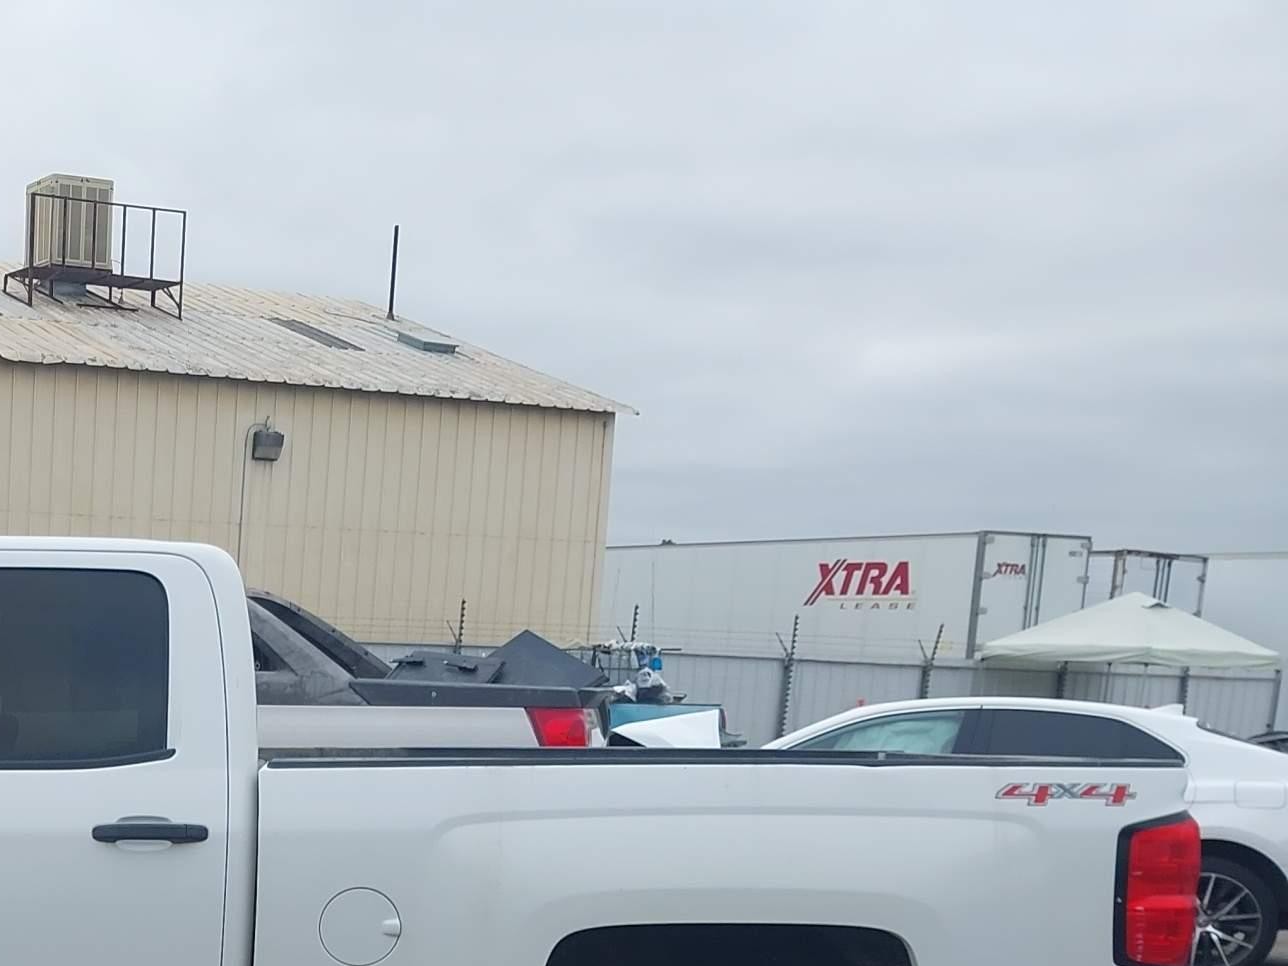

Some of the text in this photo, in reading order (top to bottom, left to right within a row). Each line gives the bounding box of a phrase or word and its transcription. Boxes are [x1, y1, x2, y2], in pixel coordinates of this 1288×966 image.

[992, 562, 1026, 578] XTRA
[803, 558, 910, 606] XTRA
[839, 602, 917, 610] LEASE
